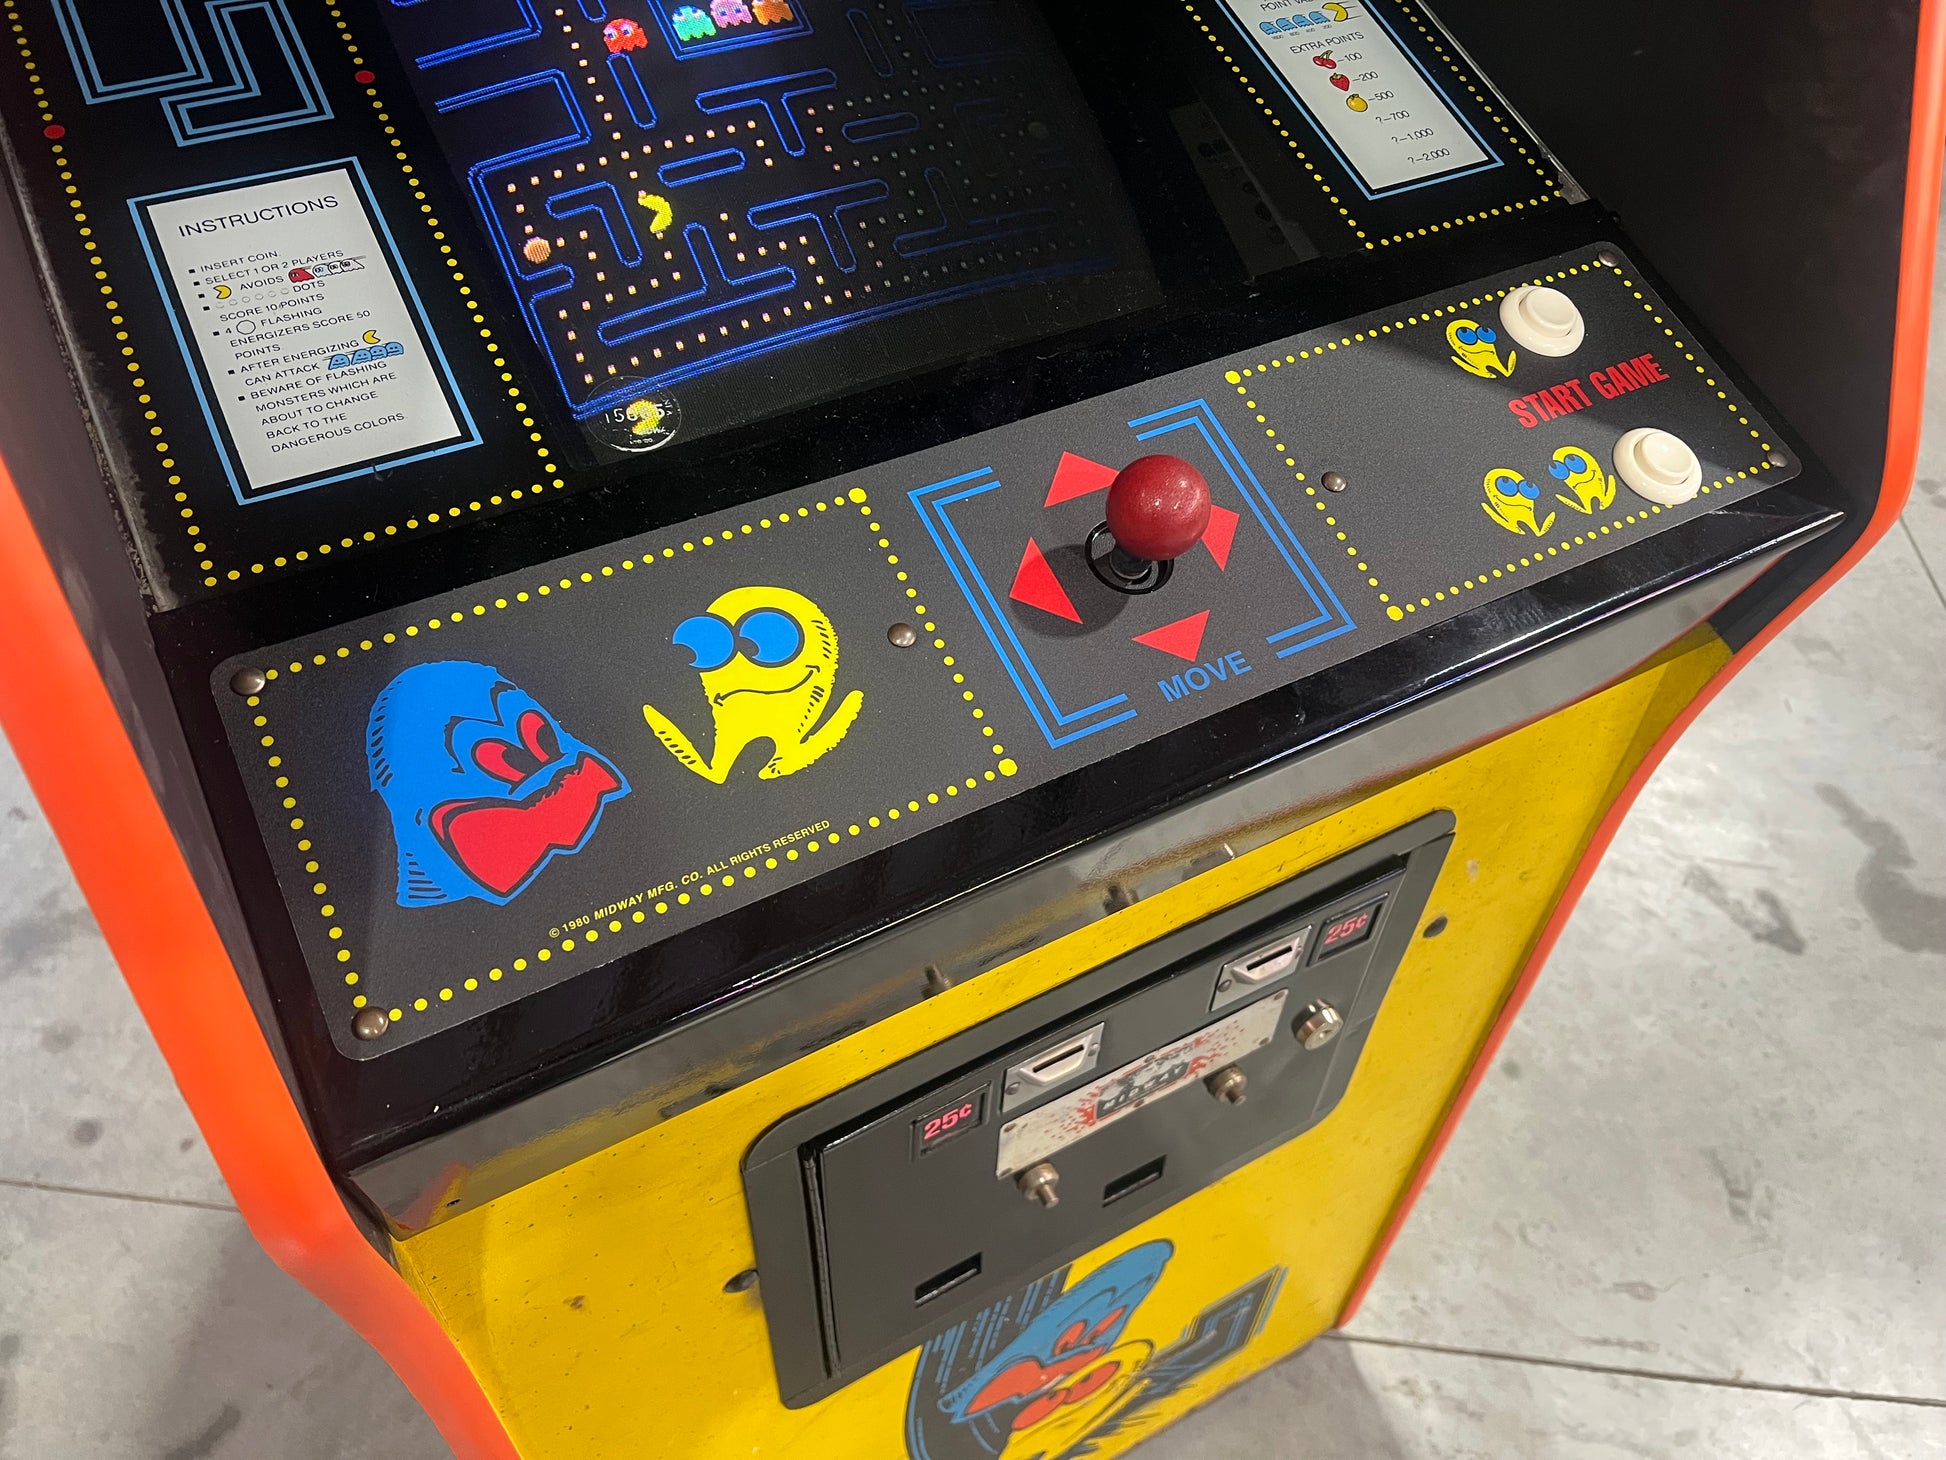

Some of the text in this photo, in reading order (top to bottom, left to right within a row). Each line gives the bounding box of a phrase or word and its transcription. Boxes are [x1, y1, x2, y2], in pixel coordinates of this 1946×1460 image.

[1290, 31, 1364, 54] EXTRA POINTS
[178, 195, 339, 237] INSTRUCTIONS
[200, 257, 244, 272] INSERT
[205, 269, 250, 285] SELECT
[261, 264, 280, 273] OR
[282, 261, 289, 269] 2
[291, 249, 344, 266] PLAYERS
[239, 275, 284, 291] AVOIDS
[292, 280, 325, 293] DOTS
[220, 293, 325, 322] SCORE 10 POINTS
[261, 307, 323, 326] FLASHING
[230, 309, 371, 347] ENERGIZERS SCORE 50
[240, 339, 359, 373] AFTER ENERGIZING
[245, 362, 320, 386] CAN ATTACK
[250, 360, 387, 399] BEWARE OF FLASHING
[1508, 353, 1670, 429] START GAME
[255, 372, 397, 412] MONSTERS WHICH ARE
[261, 390, 379, 425] ABOUT TO CHANGE
[266, 412, 347, 439] BACK TO THE
[271, 426, 352, 453] DANGEROUS
[1157, 649, 1253, 702] MOVE
[562, 915, 590, 932] 1980
[594, 893, 644, 921] MIDWAY
[647, 882, 678, 900] MFG.
[681, 871, 703, 886] CO.
[706, 861, 729, 876] ALL
[729, 843, 771, 867] RIGHTS
[773, 820, 831, 850] RESERVED
[1324, 913, 1369, 945] 25¢
[924, 1103, 973, 1140] 25¢
